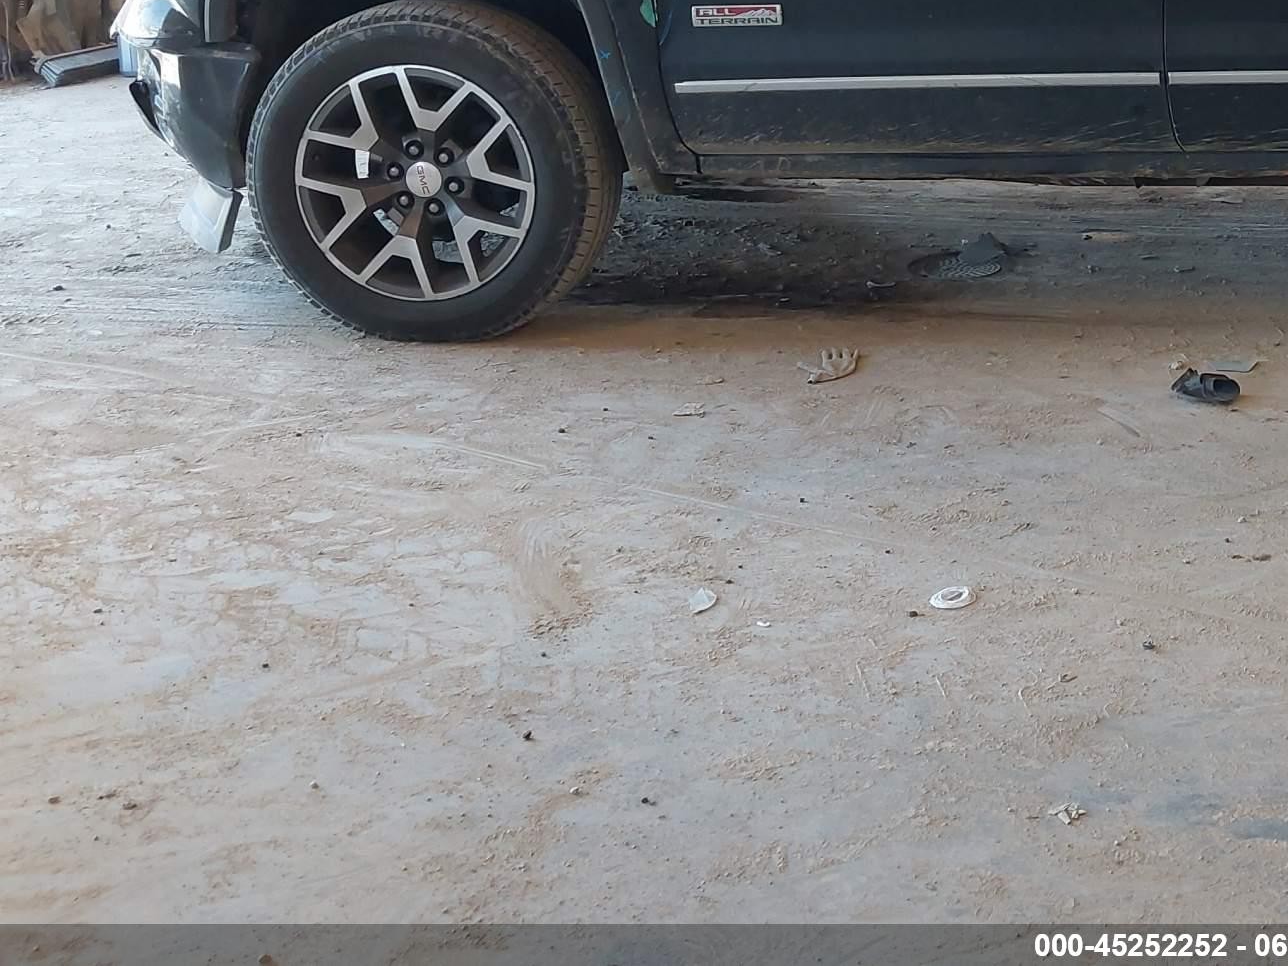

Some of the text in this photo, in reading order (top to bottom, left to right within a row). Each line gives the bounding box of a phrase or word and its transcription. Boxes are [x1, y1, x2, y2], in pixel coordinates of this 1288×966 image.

[698, 8, 736, 16] ALL
[695, 17, 778, 25] TERRAIN
[416, 165, 431, 195] GMC
